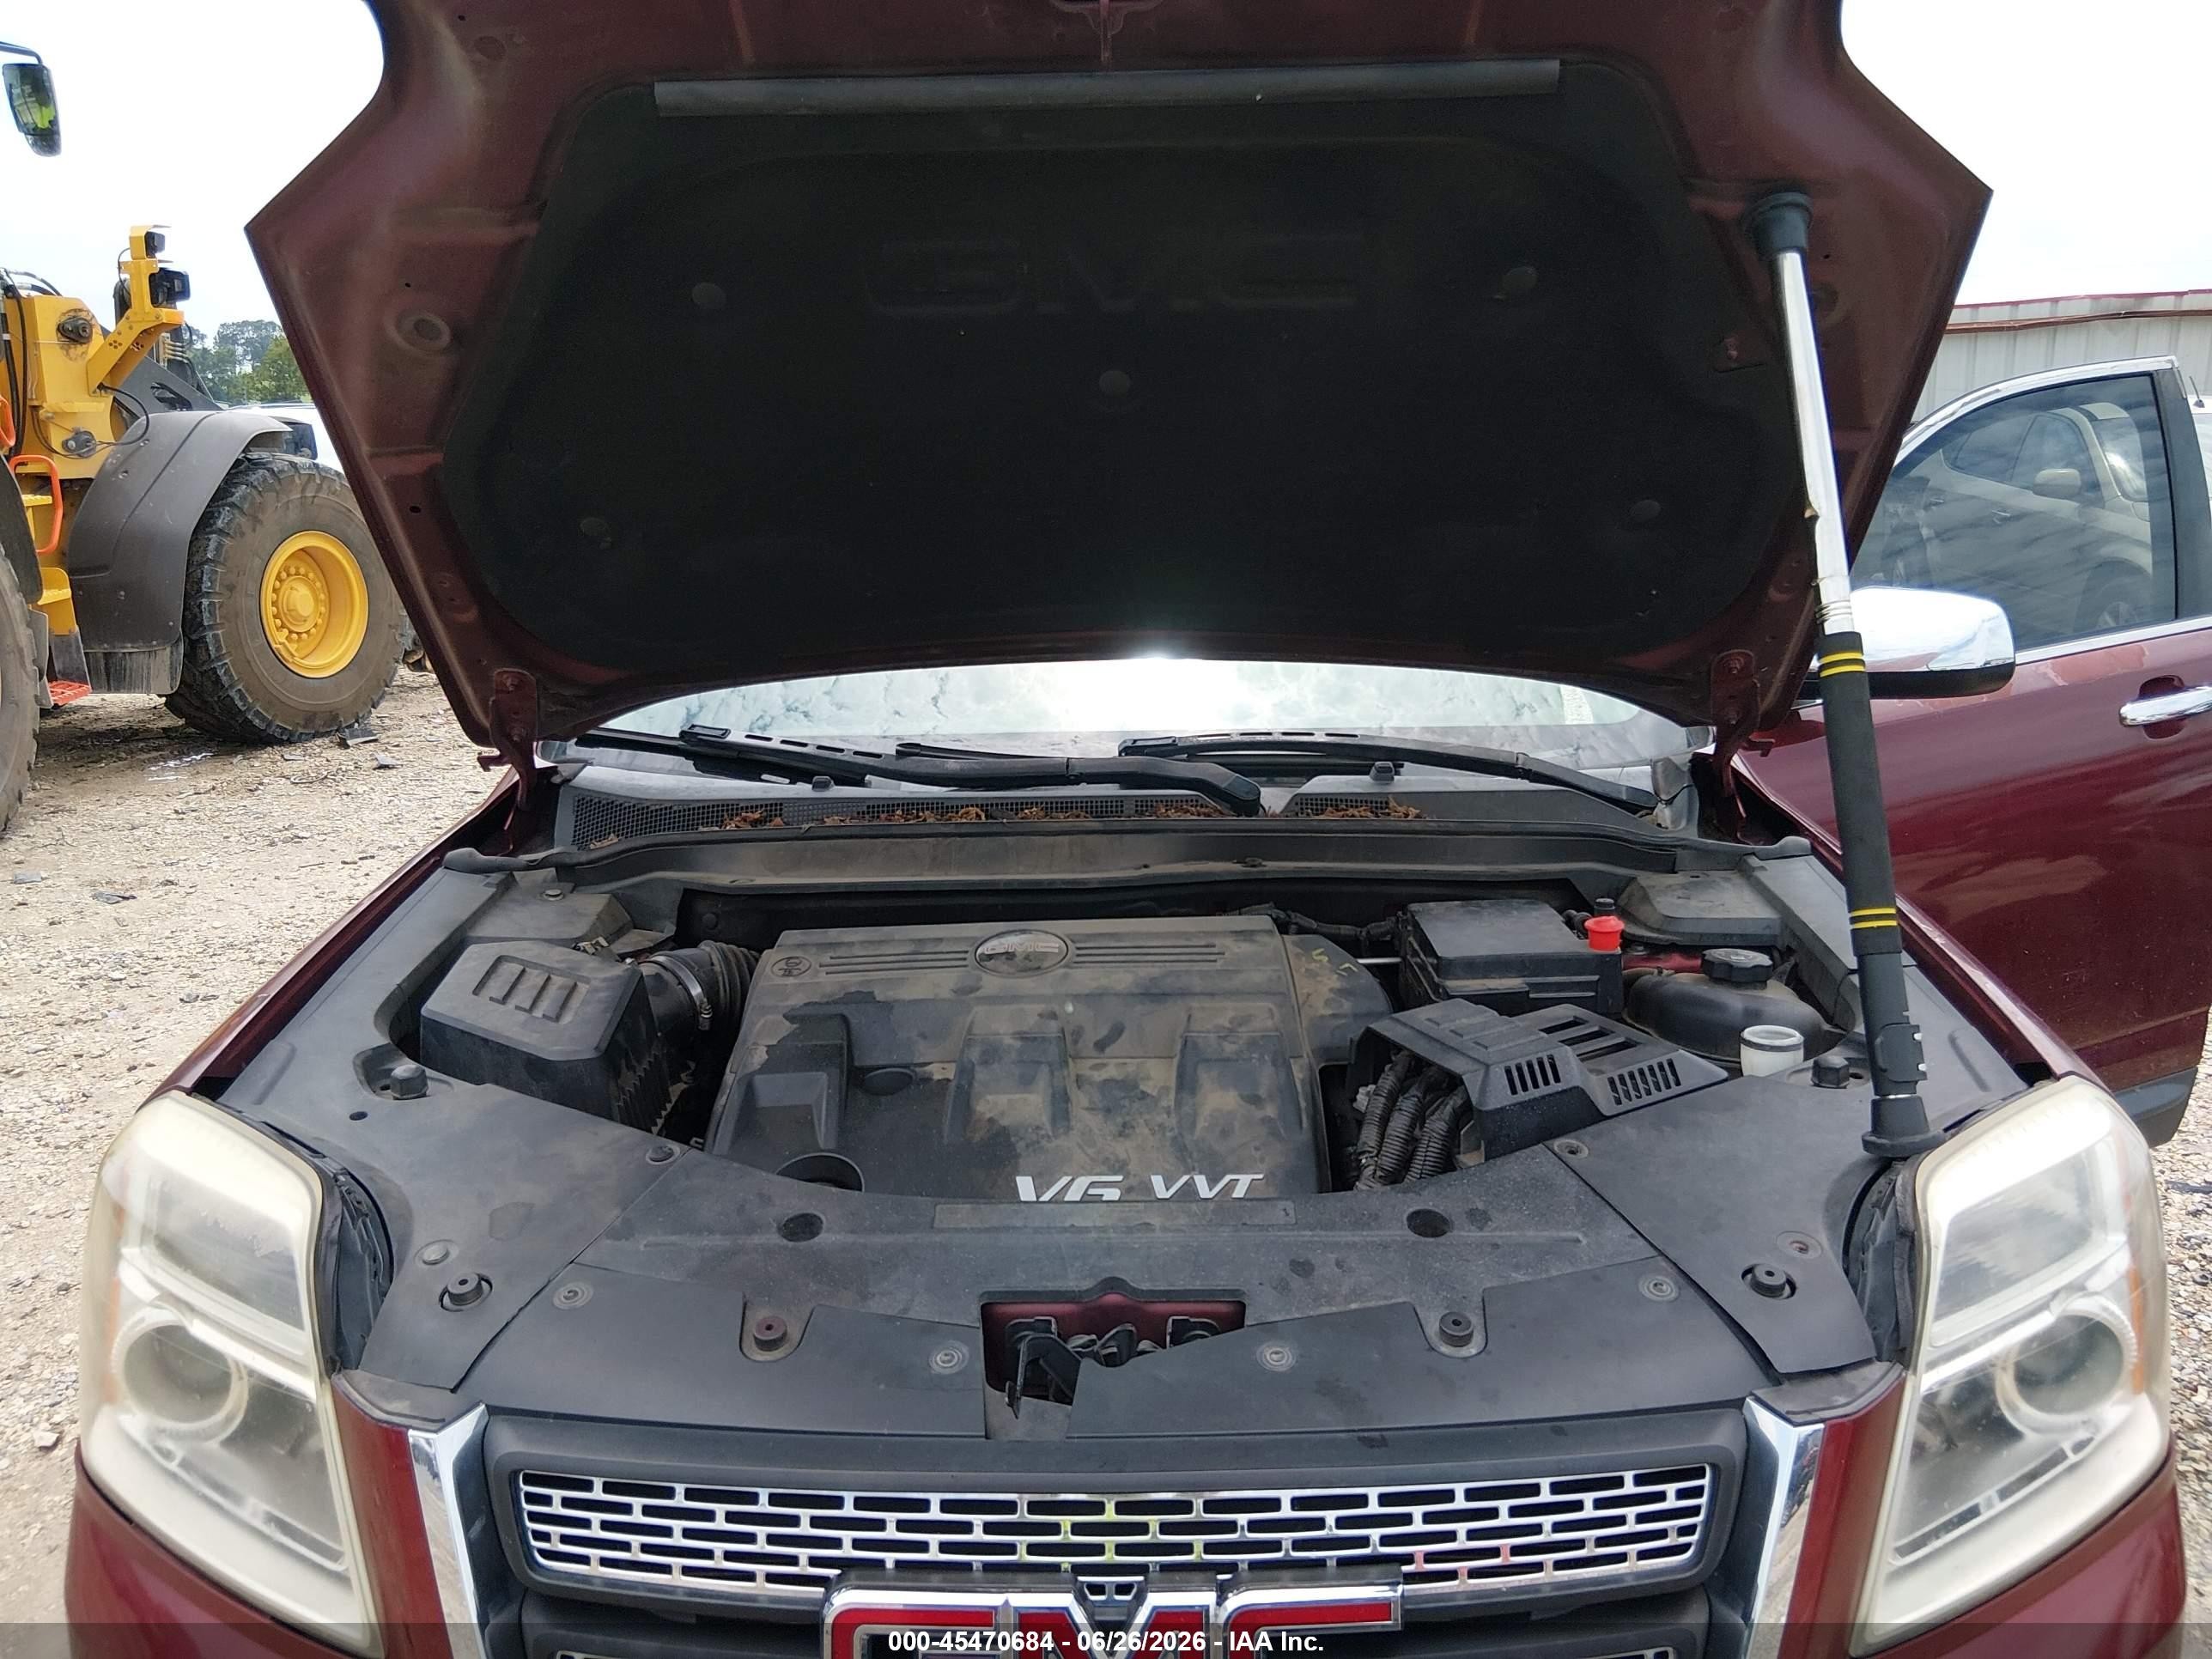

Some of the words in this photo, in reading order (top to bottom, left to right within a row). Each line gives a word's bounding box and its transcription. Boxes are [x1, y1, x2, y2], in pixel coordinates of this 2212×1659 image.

[859, 230, 1364, 315] GMC
[983, 941, 1060, 955] GMC
[1015, 1174, 1125, 1202] V6
[1149, 1173, 1265, 1200] VVT
